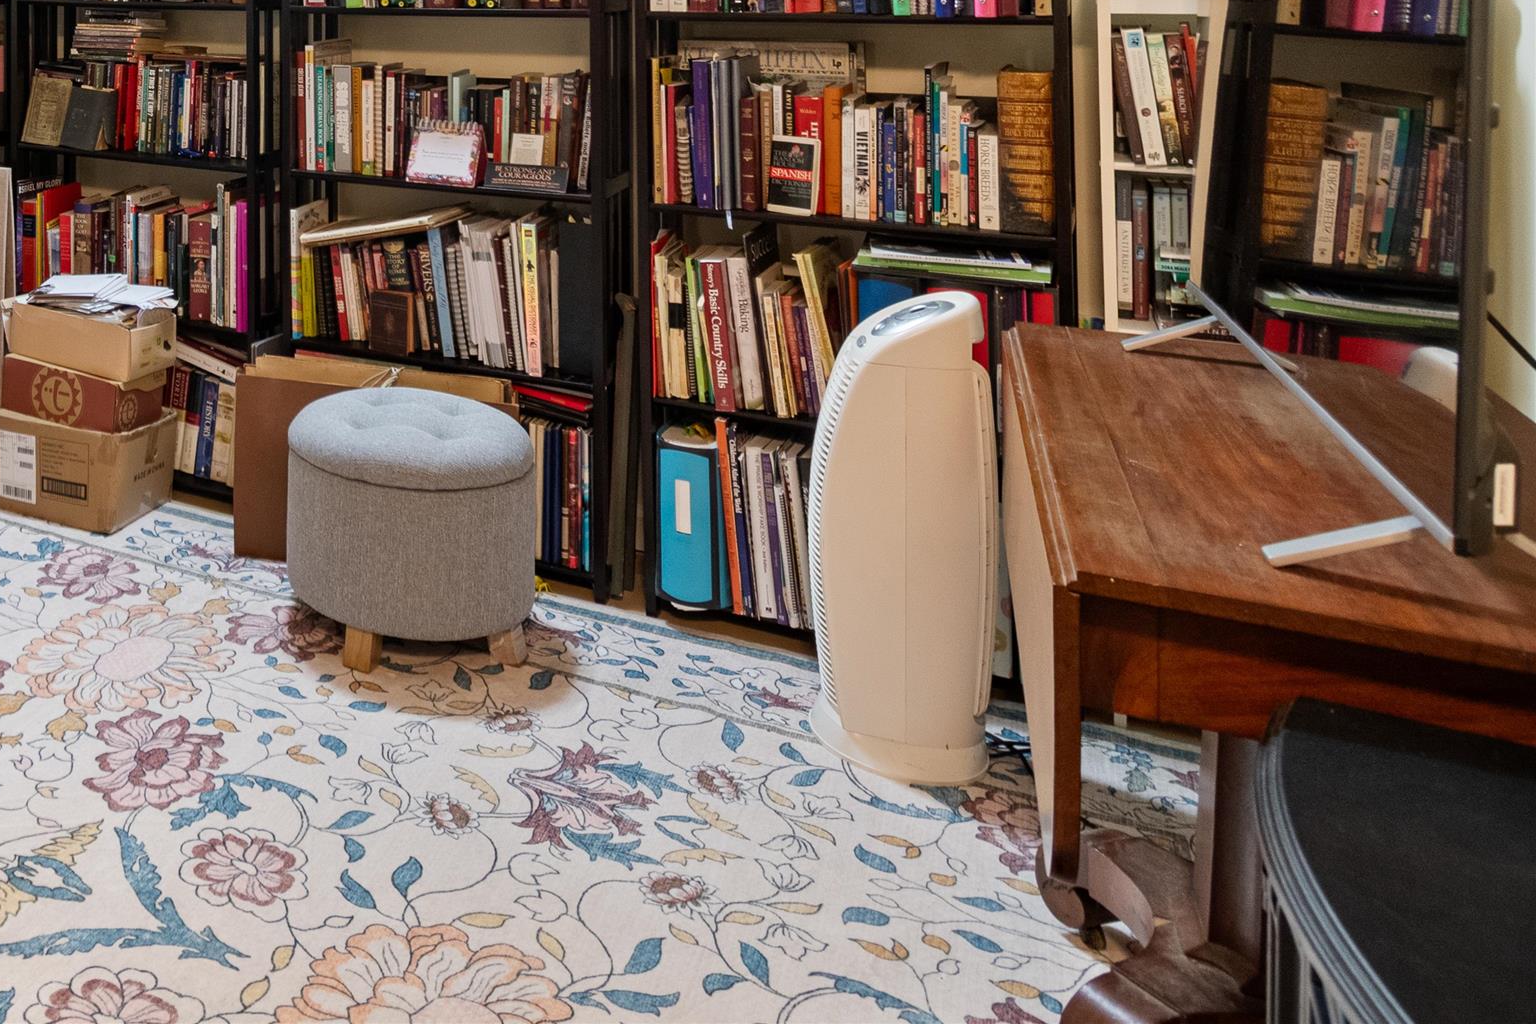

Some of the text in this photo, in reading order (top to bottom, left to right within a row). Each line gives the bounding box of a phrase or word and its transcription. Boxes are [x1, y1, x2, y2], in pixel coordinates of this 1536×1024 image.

[148, 76, 156, 90] THIS
[148, 90, 156, 101] THE
[1177, 86, 1187, 114] SEARCH
[147, 101, 156, 117] END?
[949, 110, 958, 158] FORENSICS
[1023, 129, 1045, 138] BIBLE
[856, 131, 869, 176] VIETNAM
[499, 172, 552, 181] COURAGEOUS
[504, 166, 536, 175] STRONG
[535, 168, 556, 176] AND
[579, 157, 587, 177] Bones
[770, 167, 813, 182] SPANISH
[980, 138, 992, 202] HORSE BREEDS
[18, 178, 62, 194] ISRAEL MY GLORY
[896, 187, 905, 210] LUCADO
[420, 250, 434, 293] RIVERS
[1120, 229, 1131, 294] ANTITRUST LAW
[530, 305, 538, 337] DICTIONARY
[706, 263, 729, 390] Storey's Basic Country Skills
[738, 298, 750, 334] Baking
[173, 371, 182, 406] WORLD
[202, 400, 214, 438] HISTORY
[728, 439, 737, 467] Children's
[133, 472, 146, 482] MADE
[731, 467, 739, 480] Atlas
[734, 497, 743, 514] World
